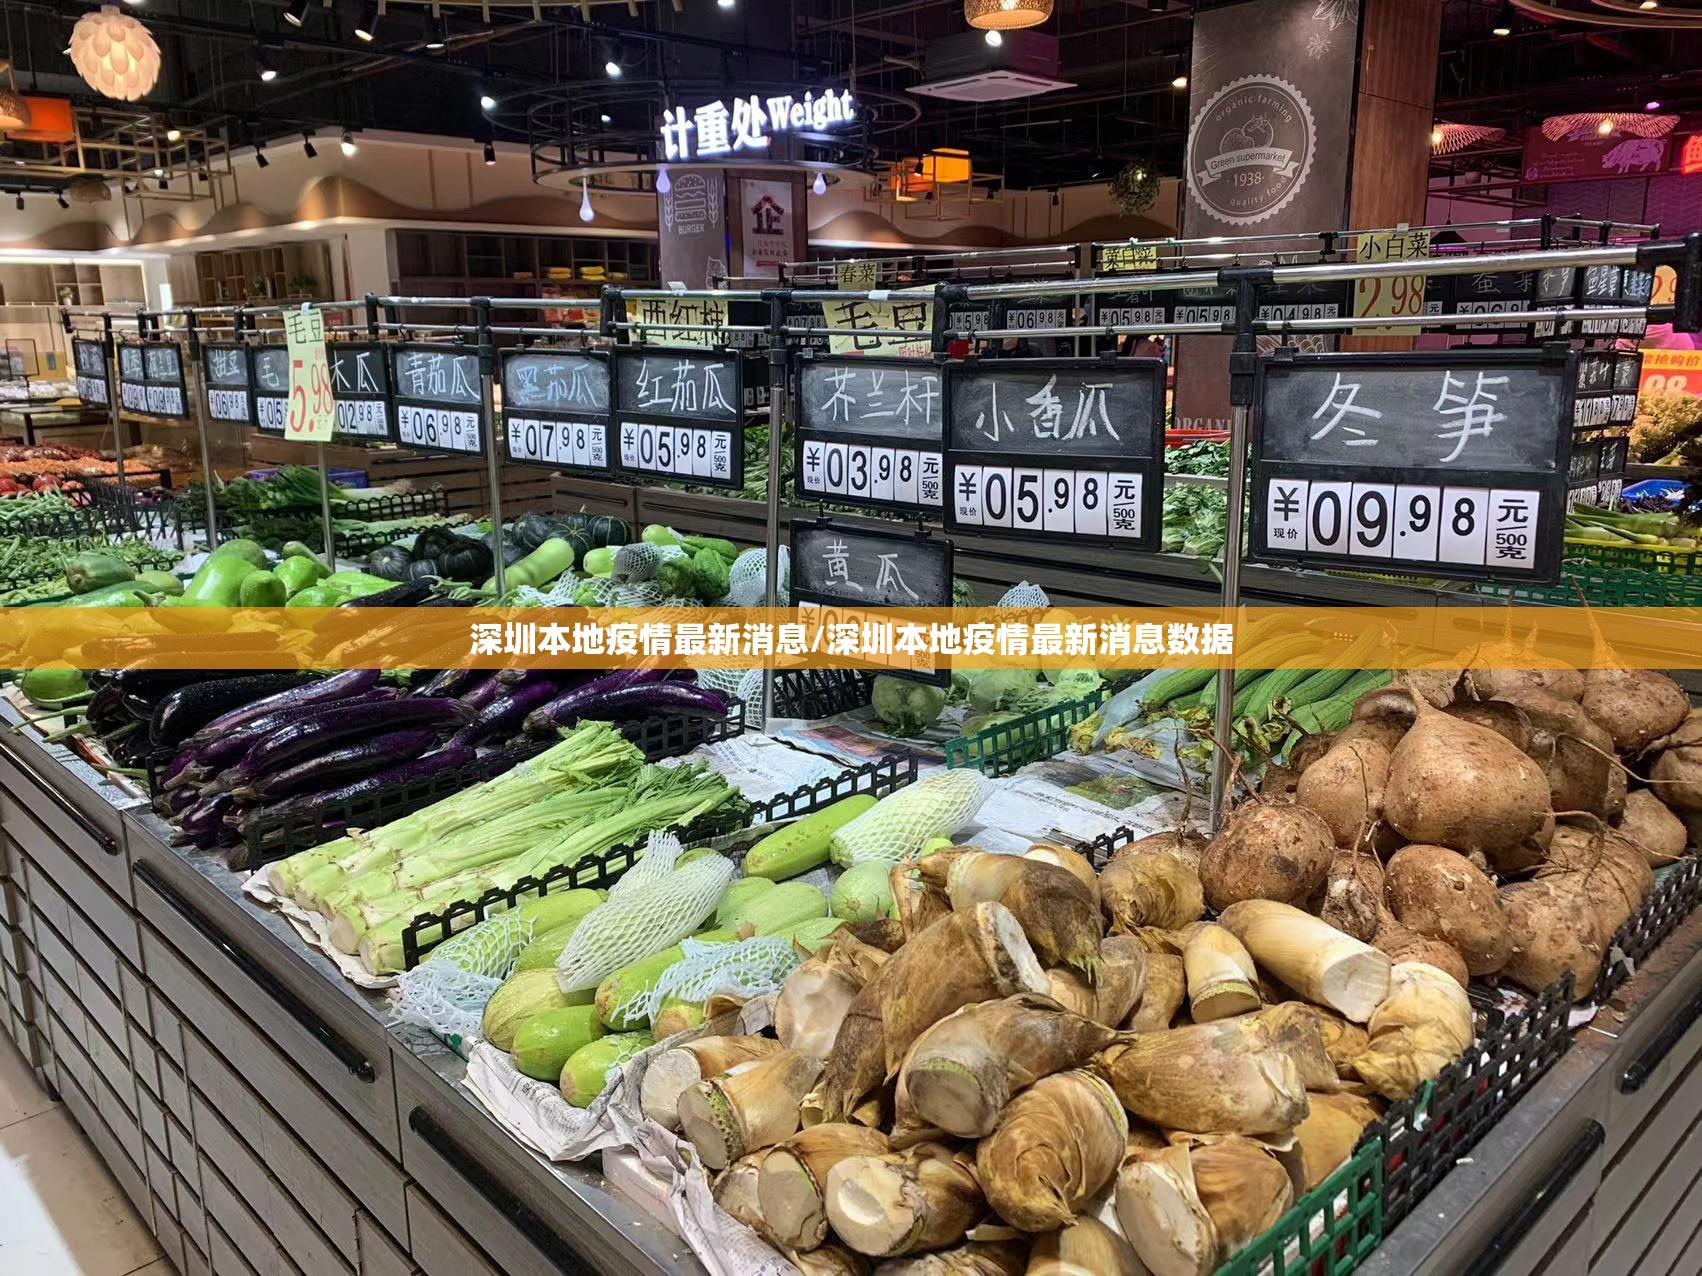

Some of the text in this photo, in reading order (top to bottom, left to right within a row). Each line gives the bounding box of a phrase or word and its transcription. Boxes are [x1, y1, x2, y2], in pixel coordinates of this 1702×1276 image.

[660, 88, 855, 160] 计重处 Weight
[1215, 94, 1293, 124] organic farming
[1210, 151, 1286, 170] Green supermarket
[1233, 171, 1262, 187] 1938
[1266, 176, 1288, 196] food
[677, 223, 705, 235] BURGER
[1359, 233, 1429, 259] 小白菜
[840, 263, 876, 283] 春菜
[288, 311, 324, 344] 毛豆
[329, 350, 379, 392] 木瓜
[404, 351, 481, 400] 青茄瓜
[636, 359, 737, 413] 红茄瓜
[975, 373, 1121, 442] 小香瓜
[822, 538, 920, 600] 黄瓜
